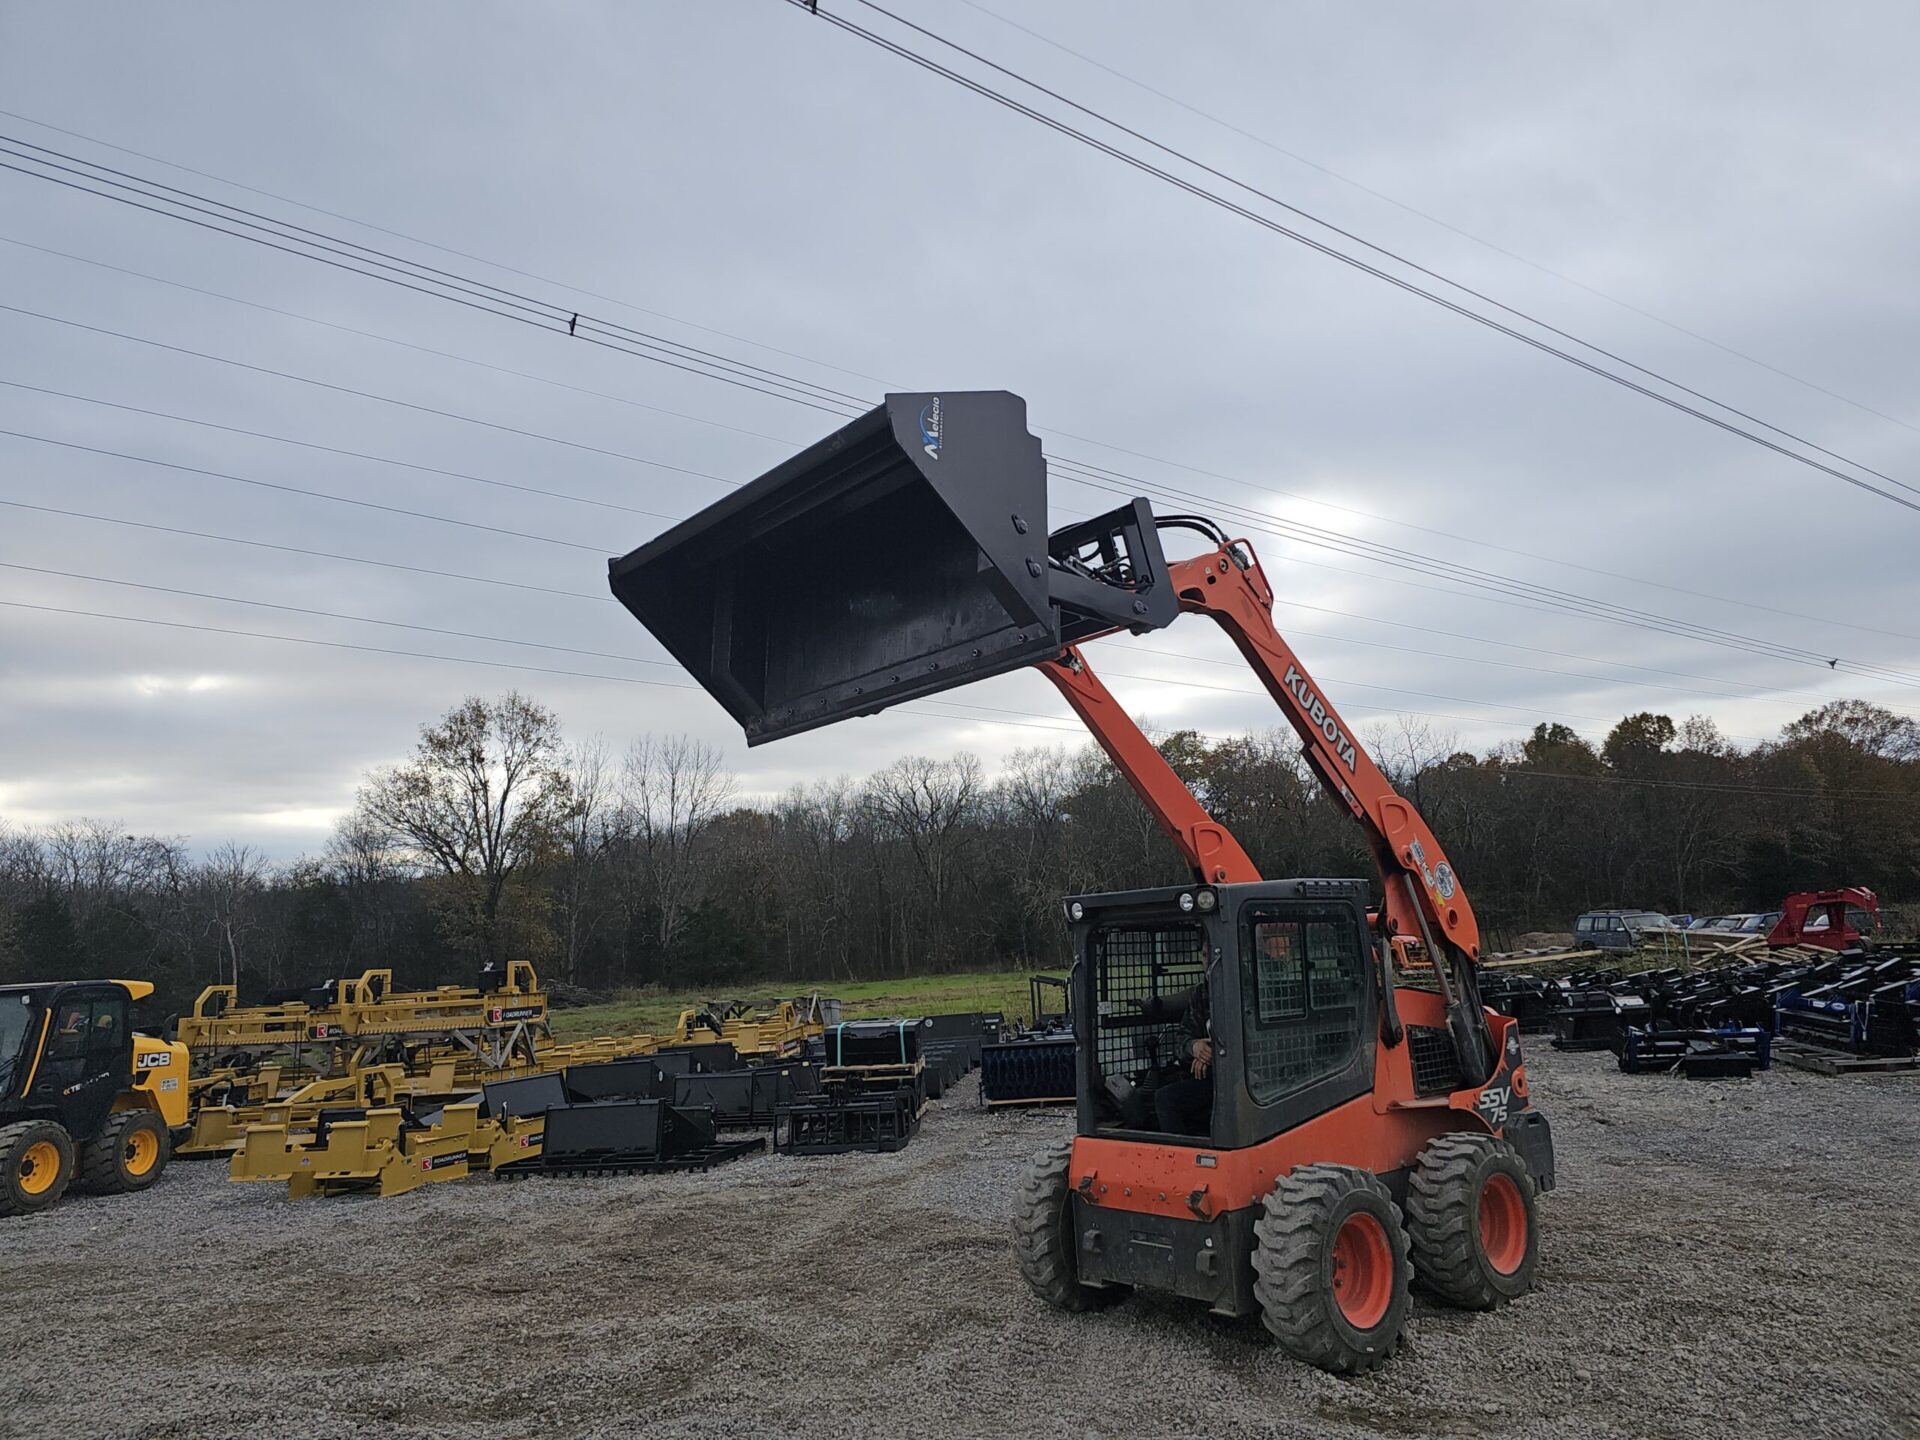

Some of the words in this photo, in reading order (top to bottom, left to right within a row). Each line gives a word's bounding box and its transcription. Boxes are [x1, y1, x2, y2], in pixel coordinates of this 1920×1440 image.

[1284, 664, 1356, 772] KUBOTA
[138, 1053, 171, 1068] JCB
[1479, 1087, 1511, 1109] SSV
[1491, 1106, 1507, 1123] 75
